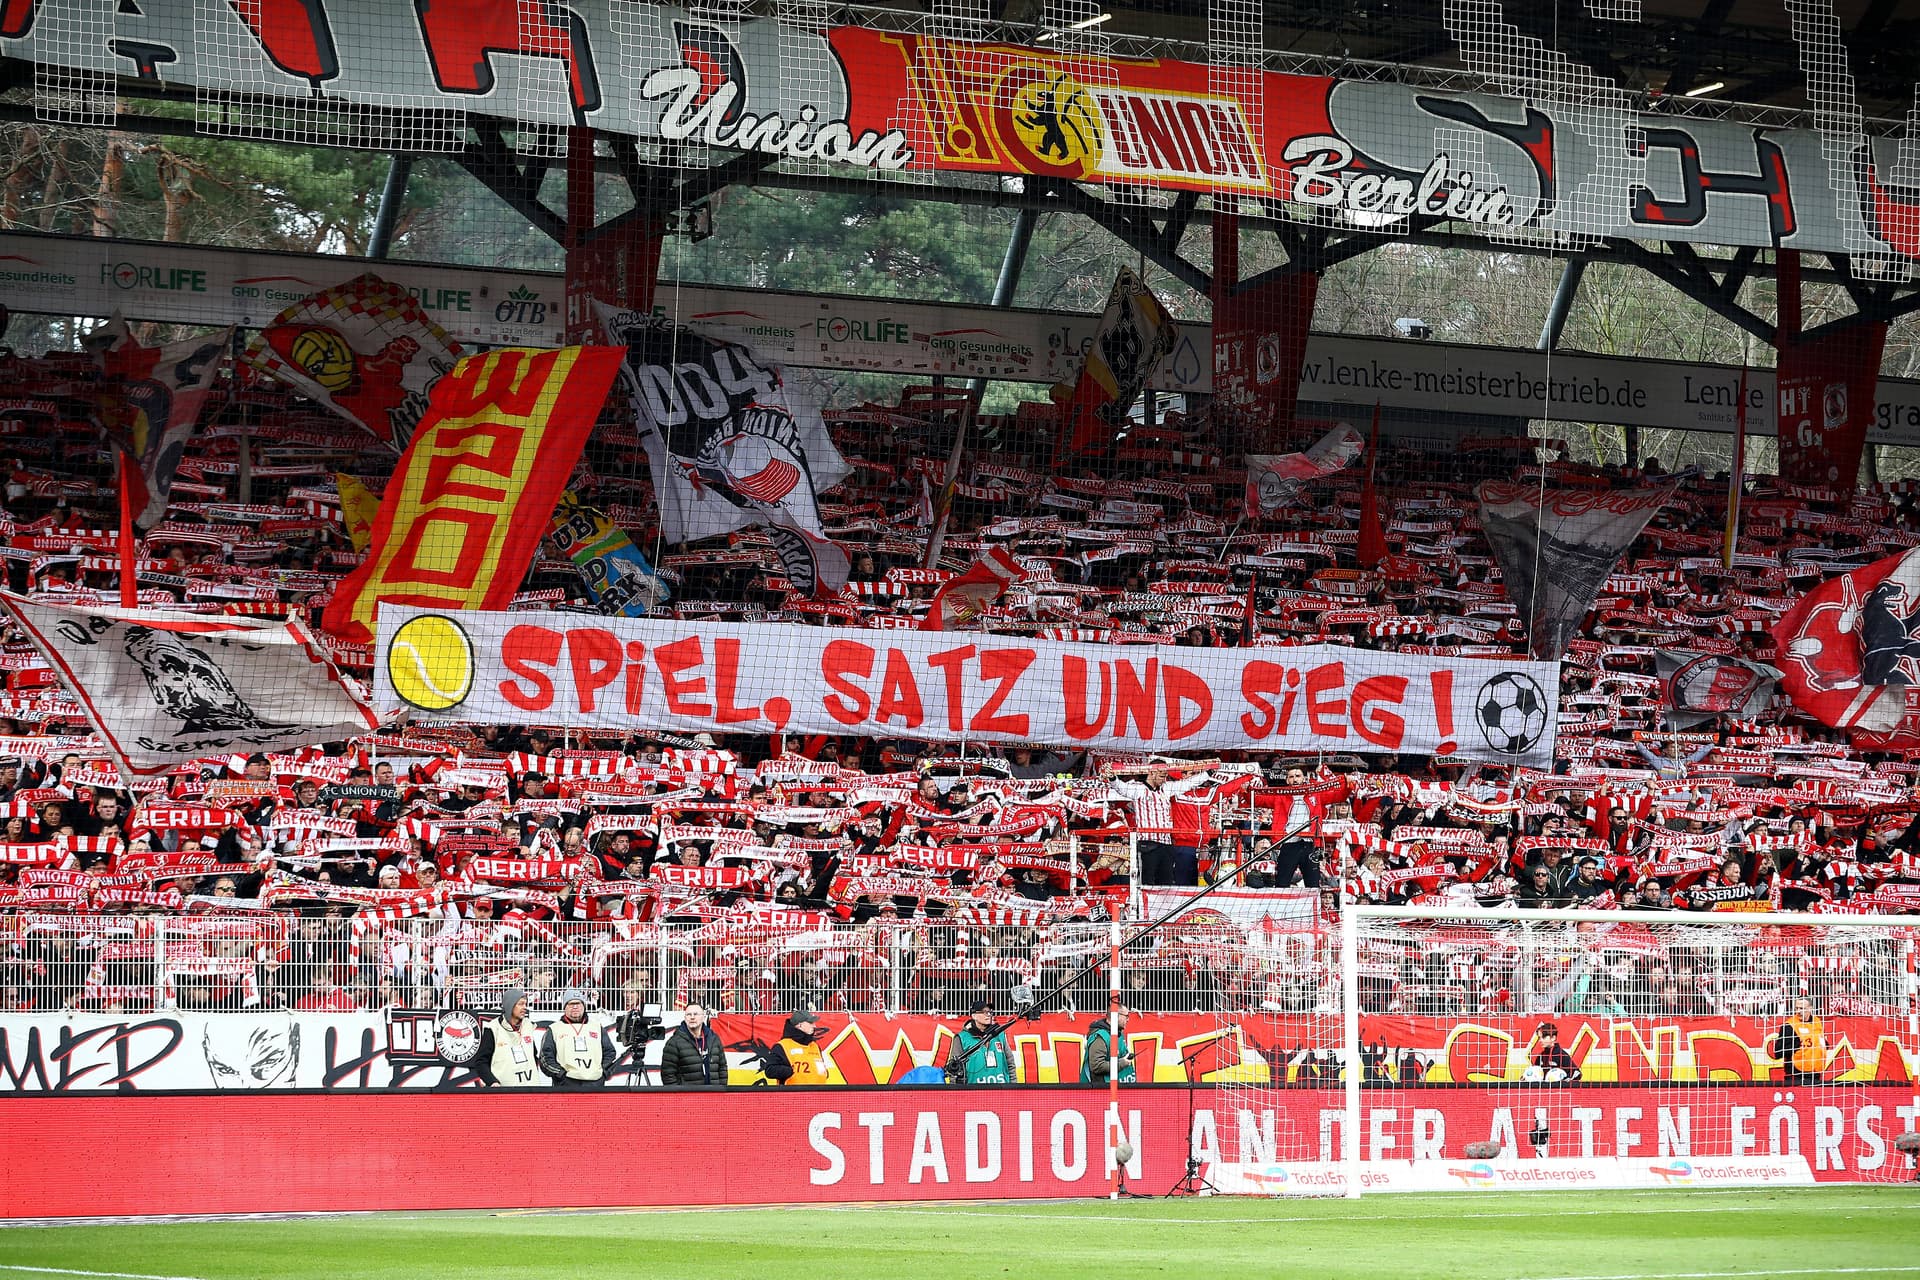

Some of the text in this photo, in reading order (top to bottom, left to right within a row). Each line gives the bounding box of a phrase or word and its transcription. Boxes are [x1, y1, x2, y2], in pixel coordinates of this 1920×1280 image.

[640, 66, 1514, 226] Union Berlin
[1099, 97, 1262, 182] UNION
[822, 640, 1037, 737] SATZ
[1062, 654, 1213, 741] UND
[341, 786, 378, 797] UNION
[588, 783, 622, 795] Union
[575, 1058, 592, 1069] TV
[516, 1070, 533, 1083] TV
[808, 1108, 1142, 1186] STADION
[1291, 1171, 1390, 1188] TotalEngies
[1500, 1168, 1597, 1183] TotalEnergies
[1694, 1165, 1787, 1181] TotalEnergies
